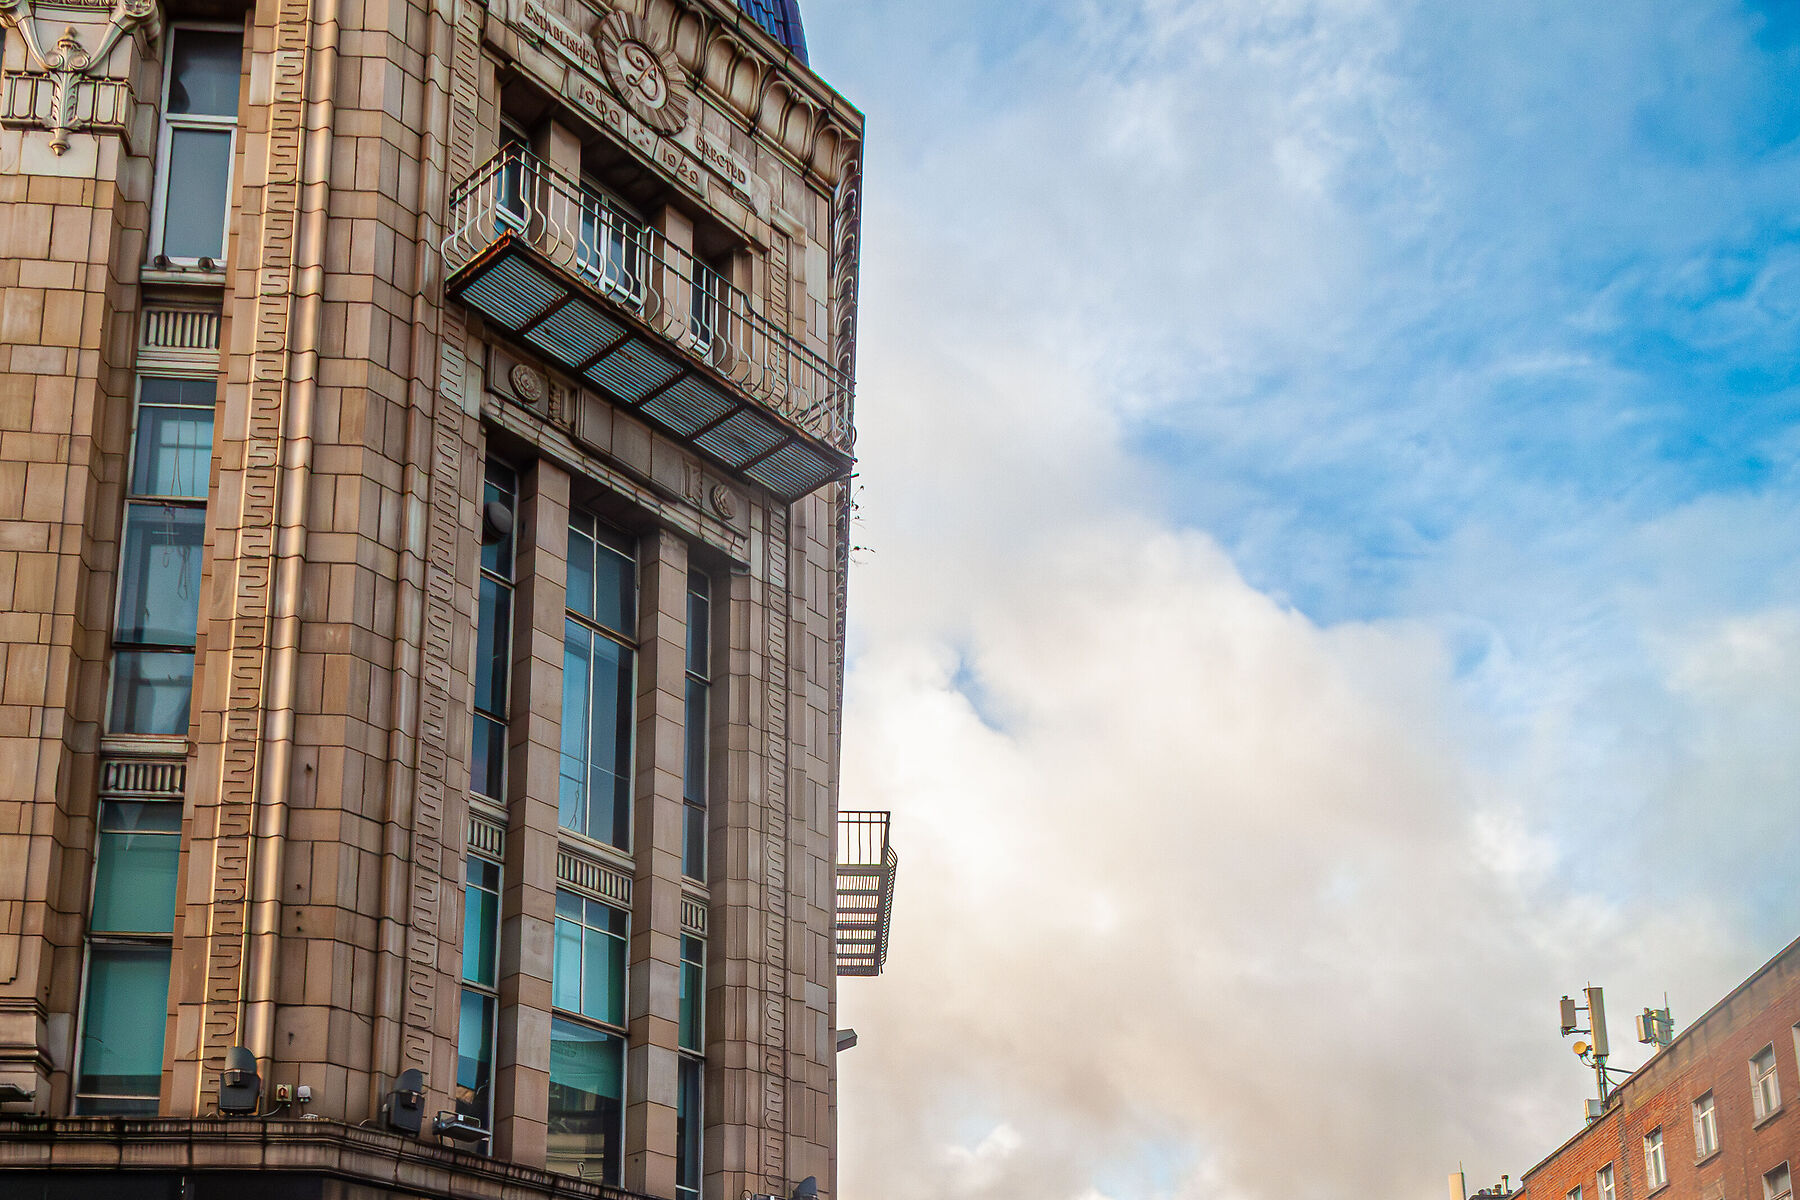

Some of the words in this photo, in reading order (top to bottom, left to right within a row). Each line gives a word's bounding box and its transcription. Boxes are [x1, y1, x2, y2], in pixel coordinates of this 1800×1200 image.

[525, 2, 600, 71] ESTABLISHED
[577, 84, 621, 126] 1900
[661, 147, 699, 185] 1929
[696, 133, 747, 184] ERECTED
